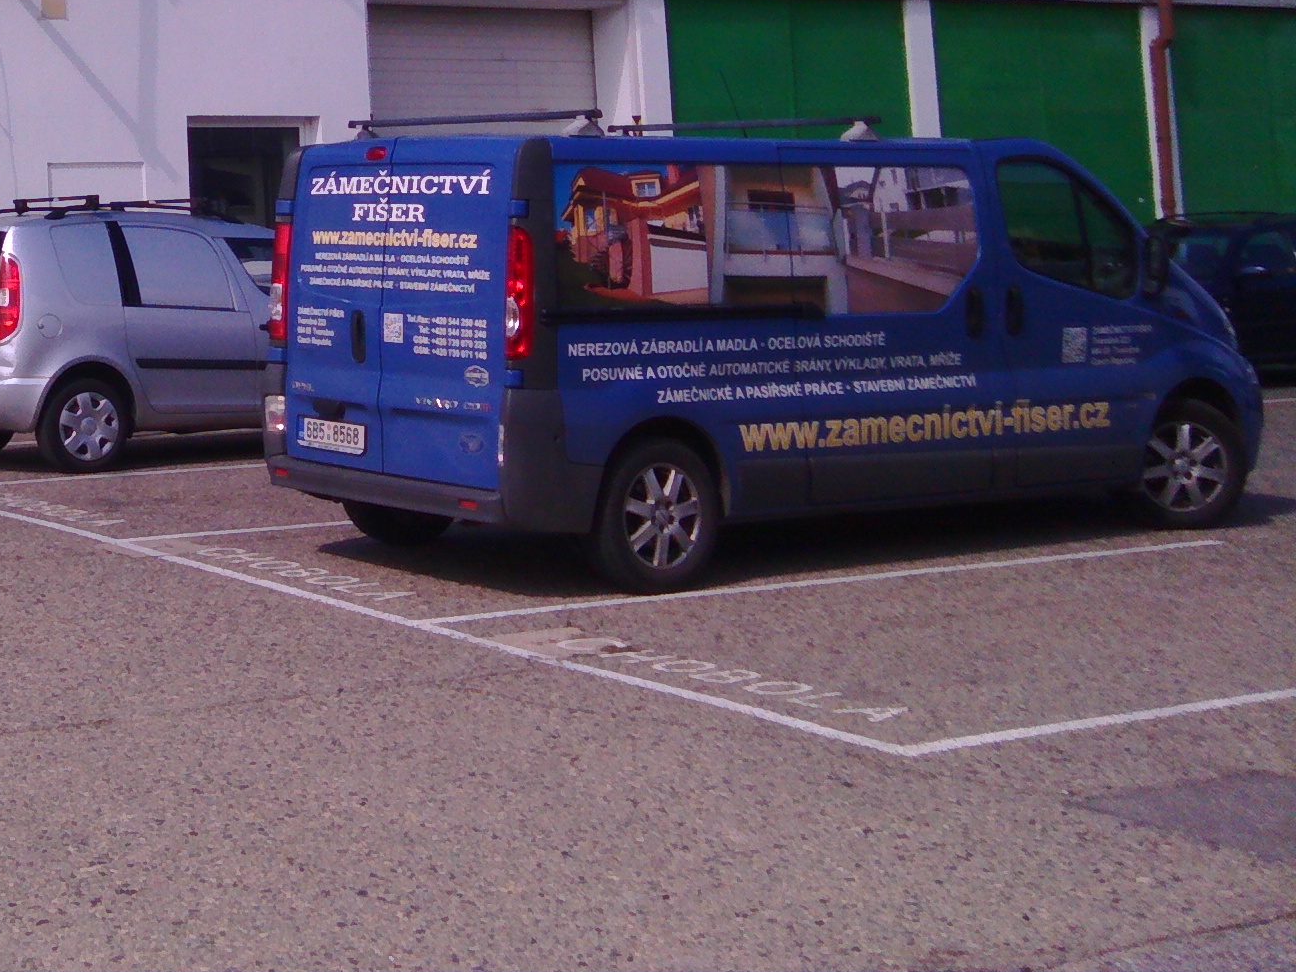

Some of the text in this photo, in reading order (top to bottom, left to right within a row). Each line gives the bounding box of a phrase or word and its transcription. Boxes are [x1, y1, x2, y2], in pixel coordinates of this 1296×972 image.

[311, 169, 491, 195] ZÁMEČNICTVÍ
[352, 197, 426, 222] FIŠER
[312, 228, 478, 249] www.zamecnictvi-fiser.cz
[568, 331, 886, 357] NEREZOVÁ ZÁBRADLÍ A MADLA OCELOVÁ SCHODIŠTĚ
[582, 364, 644, 382] POSUVNÉ
[646, 367, 656, 379] A
[657, 362, 706, 378] OTOČNÉ
[709, 358, 790, 376] AUTOMATICKÉ
[657, 373, 977, 404] ZÁMEČNICKÉ A PASÍŘSKÉ PRÁCE STAVEBNÍ ZÁMEČNICTVÍ
[306, 420, 360, 446] 6B5 8568
[739, 398, 1112, 452] www.zamecnictvi-fiser.cz
[556, 636, 911, 724] CHOBOLA
